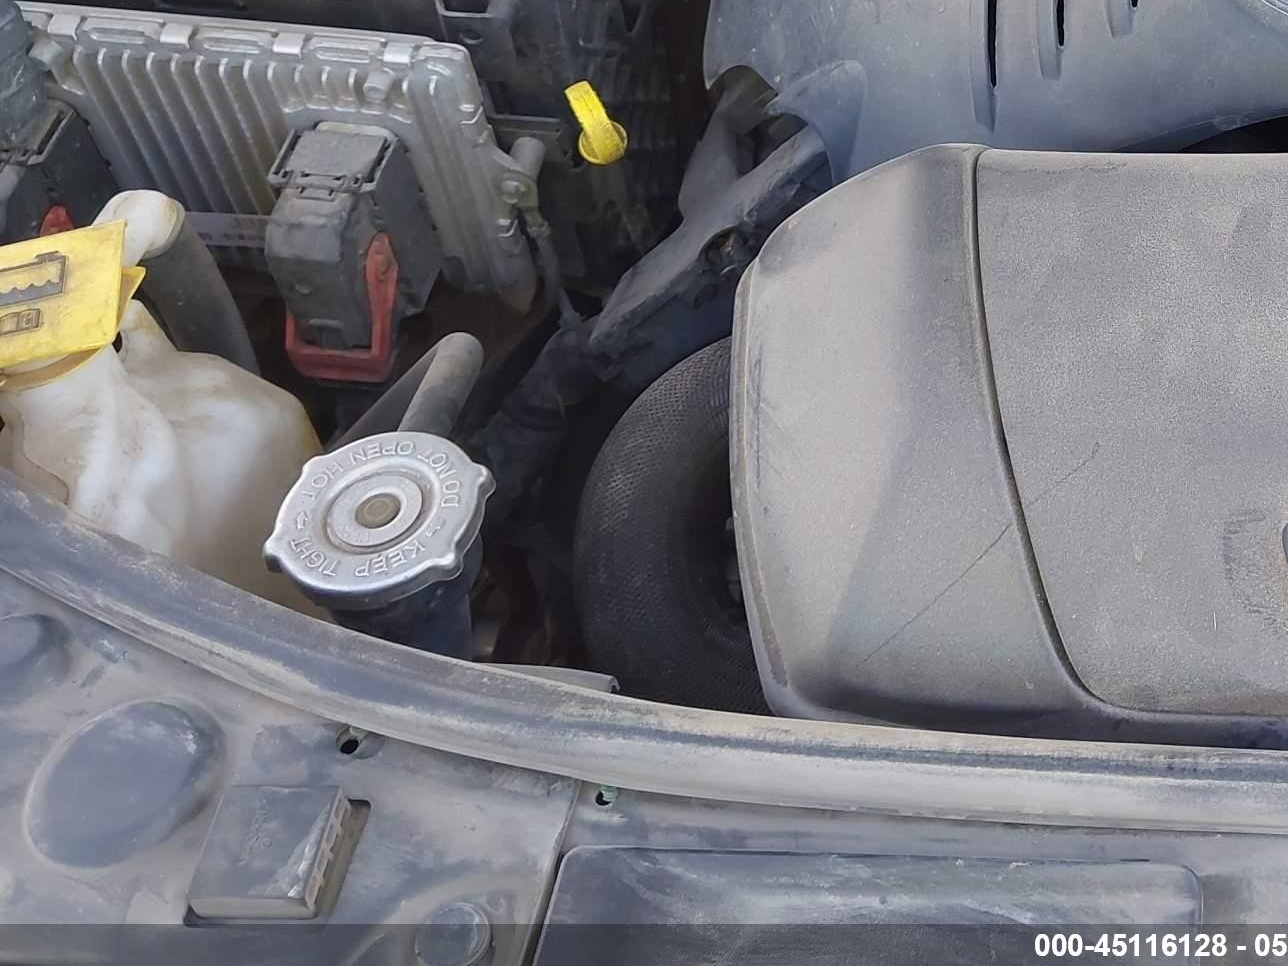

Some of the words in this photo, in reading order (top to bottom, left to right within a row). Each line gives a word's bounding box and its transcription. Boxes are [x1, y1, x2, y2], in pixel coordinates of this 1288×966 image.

[350, 441, 416, 466] OPEN
[417, 453, 457, 480] NOT
[301, 461, 345, 501] HOT
[441, 480, 462, 508] DO
[290, 537, 341, 578] TIGHT
[355, 540, 426, 578] KEEP
